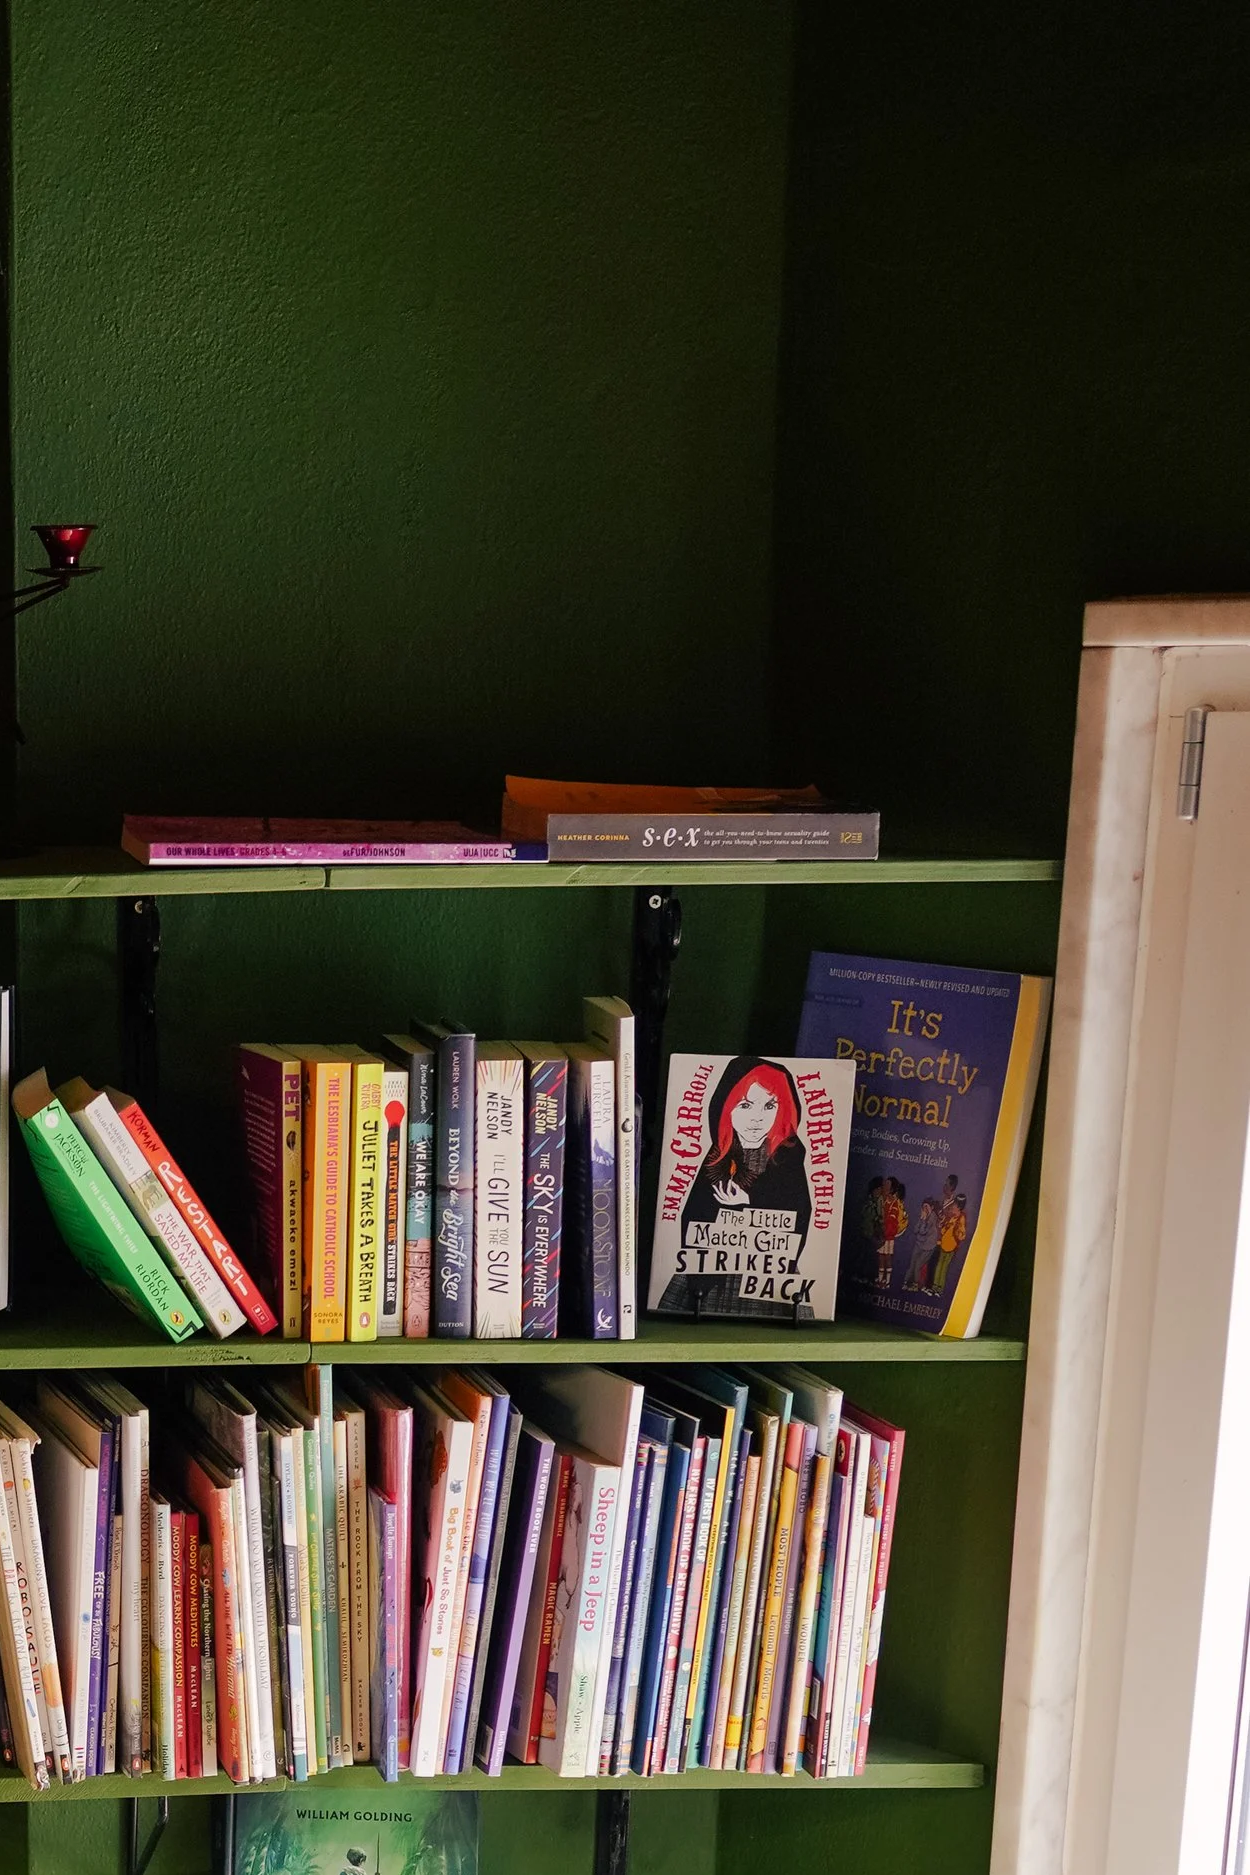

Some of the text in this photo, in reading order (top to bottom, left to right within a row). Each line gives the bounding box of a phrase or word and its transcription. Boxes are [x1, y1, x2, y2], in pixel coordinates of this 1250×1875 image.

[888, 1000, 942, 1039] It's
[836, 1038, 978, 1094] Perfectly
[283, 1074, 301, 1122] PET
[659, 1064, 714, 1222] EMMA CARROLL
[796, 1071, 835, 1230] LAUREN CHILD
[359, 1120, 380, 1303] JULIET TAKES A BREATH
[721, 1210, 791, 1228] The Little
[675, 1251, 787, 1273] STRIKES
[694, 1228, 790, 1250] Match Girl
[744, 1277, 815, 1304] BACK
[579, 1486, 616, 1633] Sheep in a Jeep
[543, 1582, 557, 1644] MAGIC RAMEN
[296, 1809, 412, 1823] WILLIAM GOLDING
